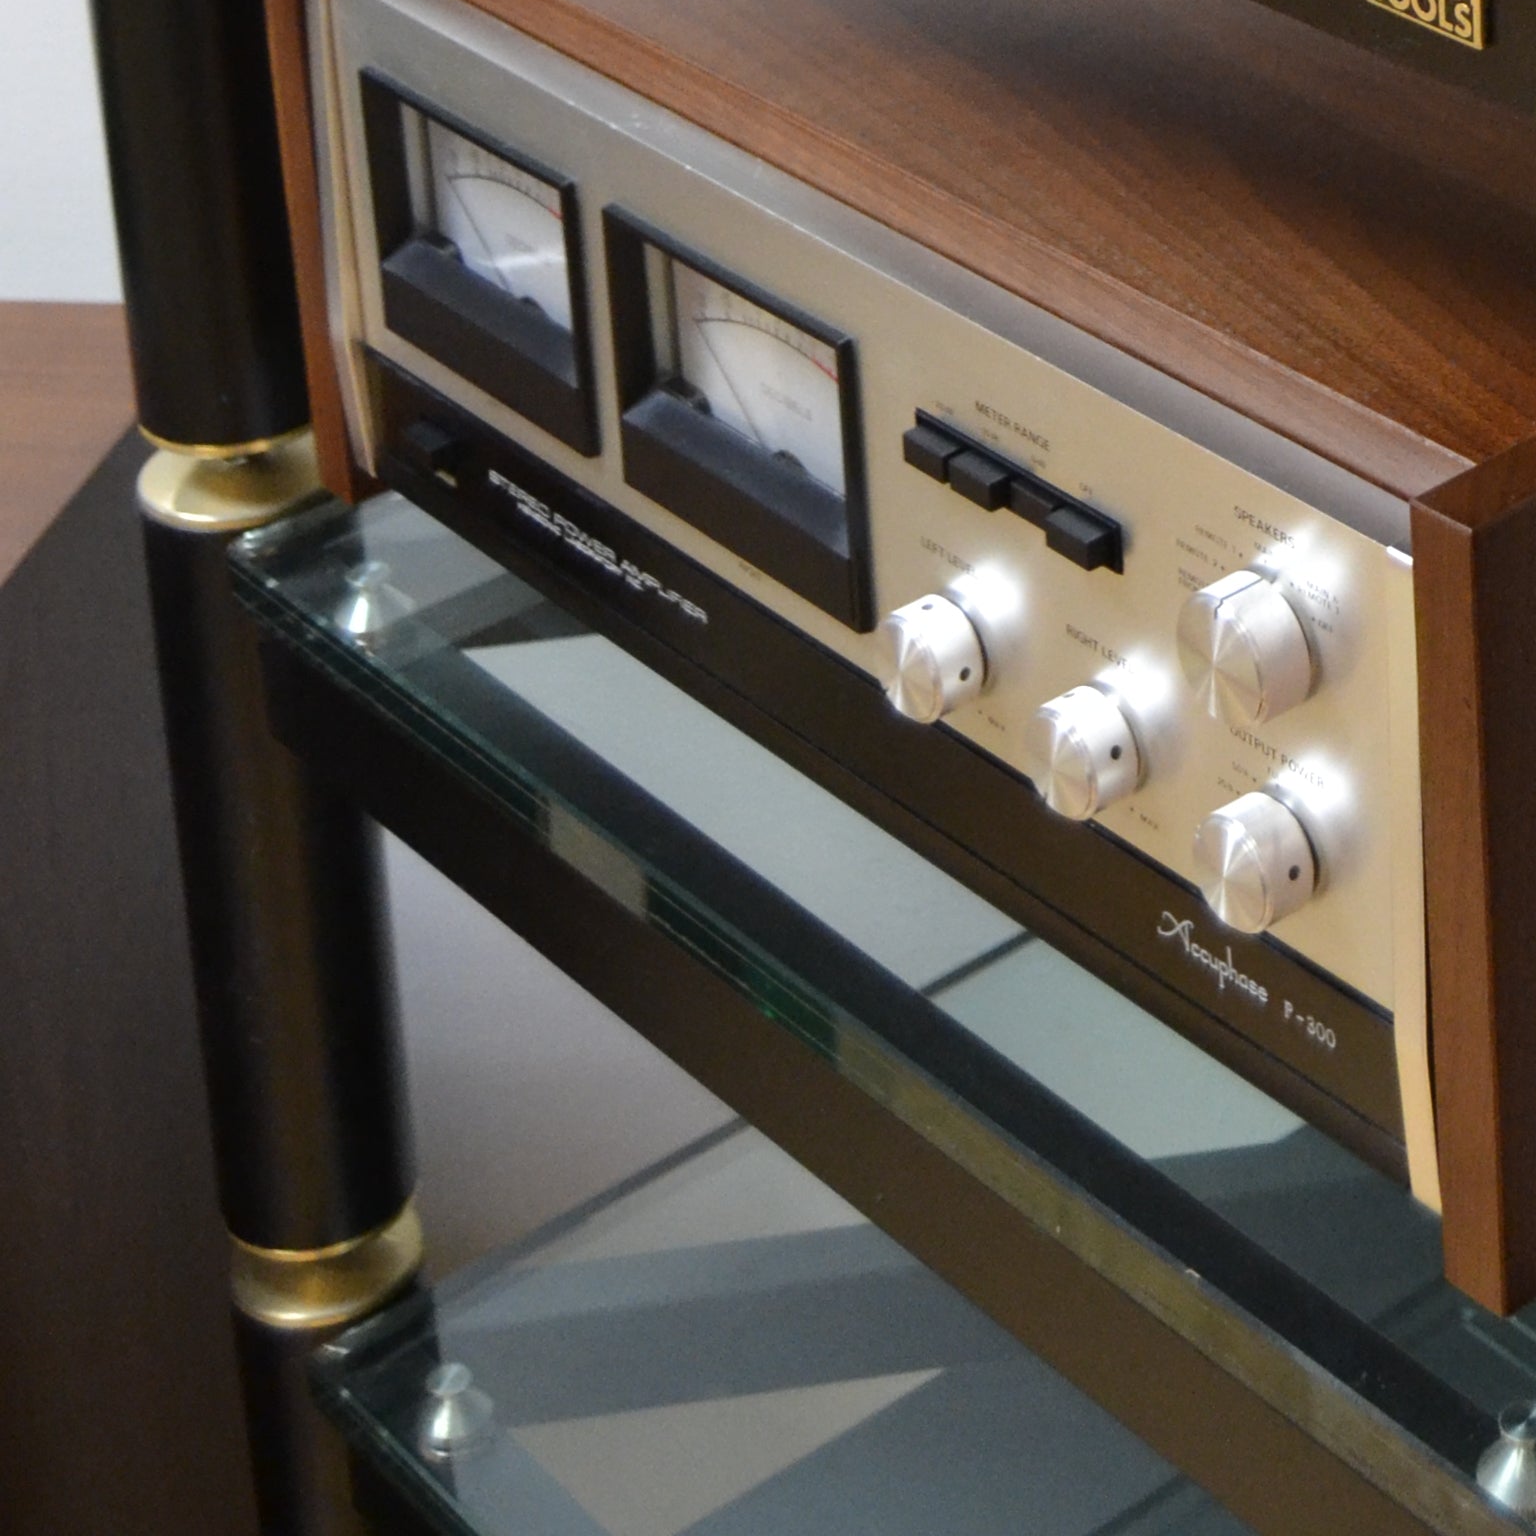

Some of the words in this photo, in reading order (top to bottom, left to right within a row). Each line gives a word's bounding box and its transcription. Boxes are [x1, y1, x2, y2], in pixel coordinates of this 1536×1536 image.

[975, 400, 1011, 428] METER
[1013, 422, 1050, 453] RANGE
[920, 535, 945, 558] LEFT
[1234, 504, 1295, 549] SPEAKERS
[1066, 623, 1098, 652] RIGHT
[1230, 727, 1277, 760] OUTPUT
[1280, 753, 1325, 790] POWER
[1157, 911, 1269, 1003] Accuphase
[1283, 999, 1337, 1049] P-300
